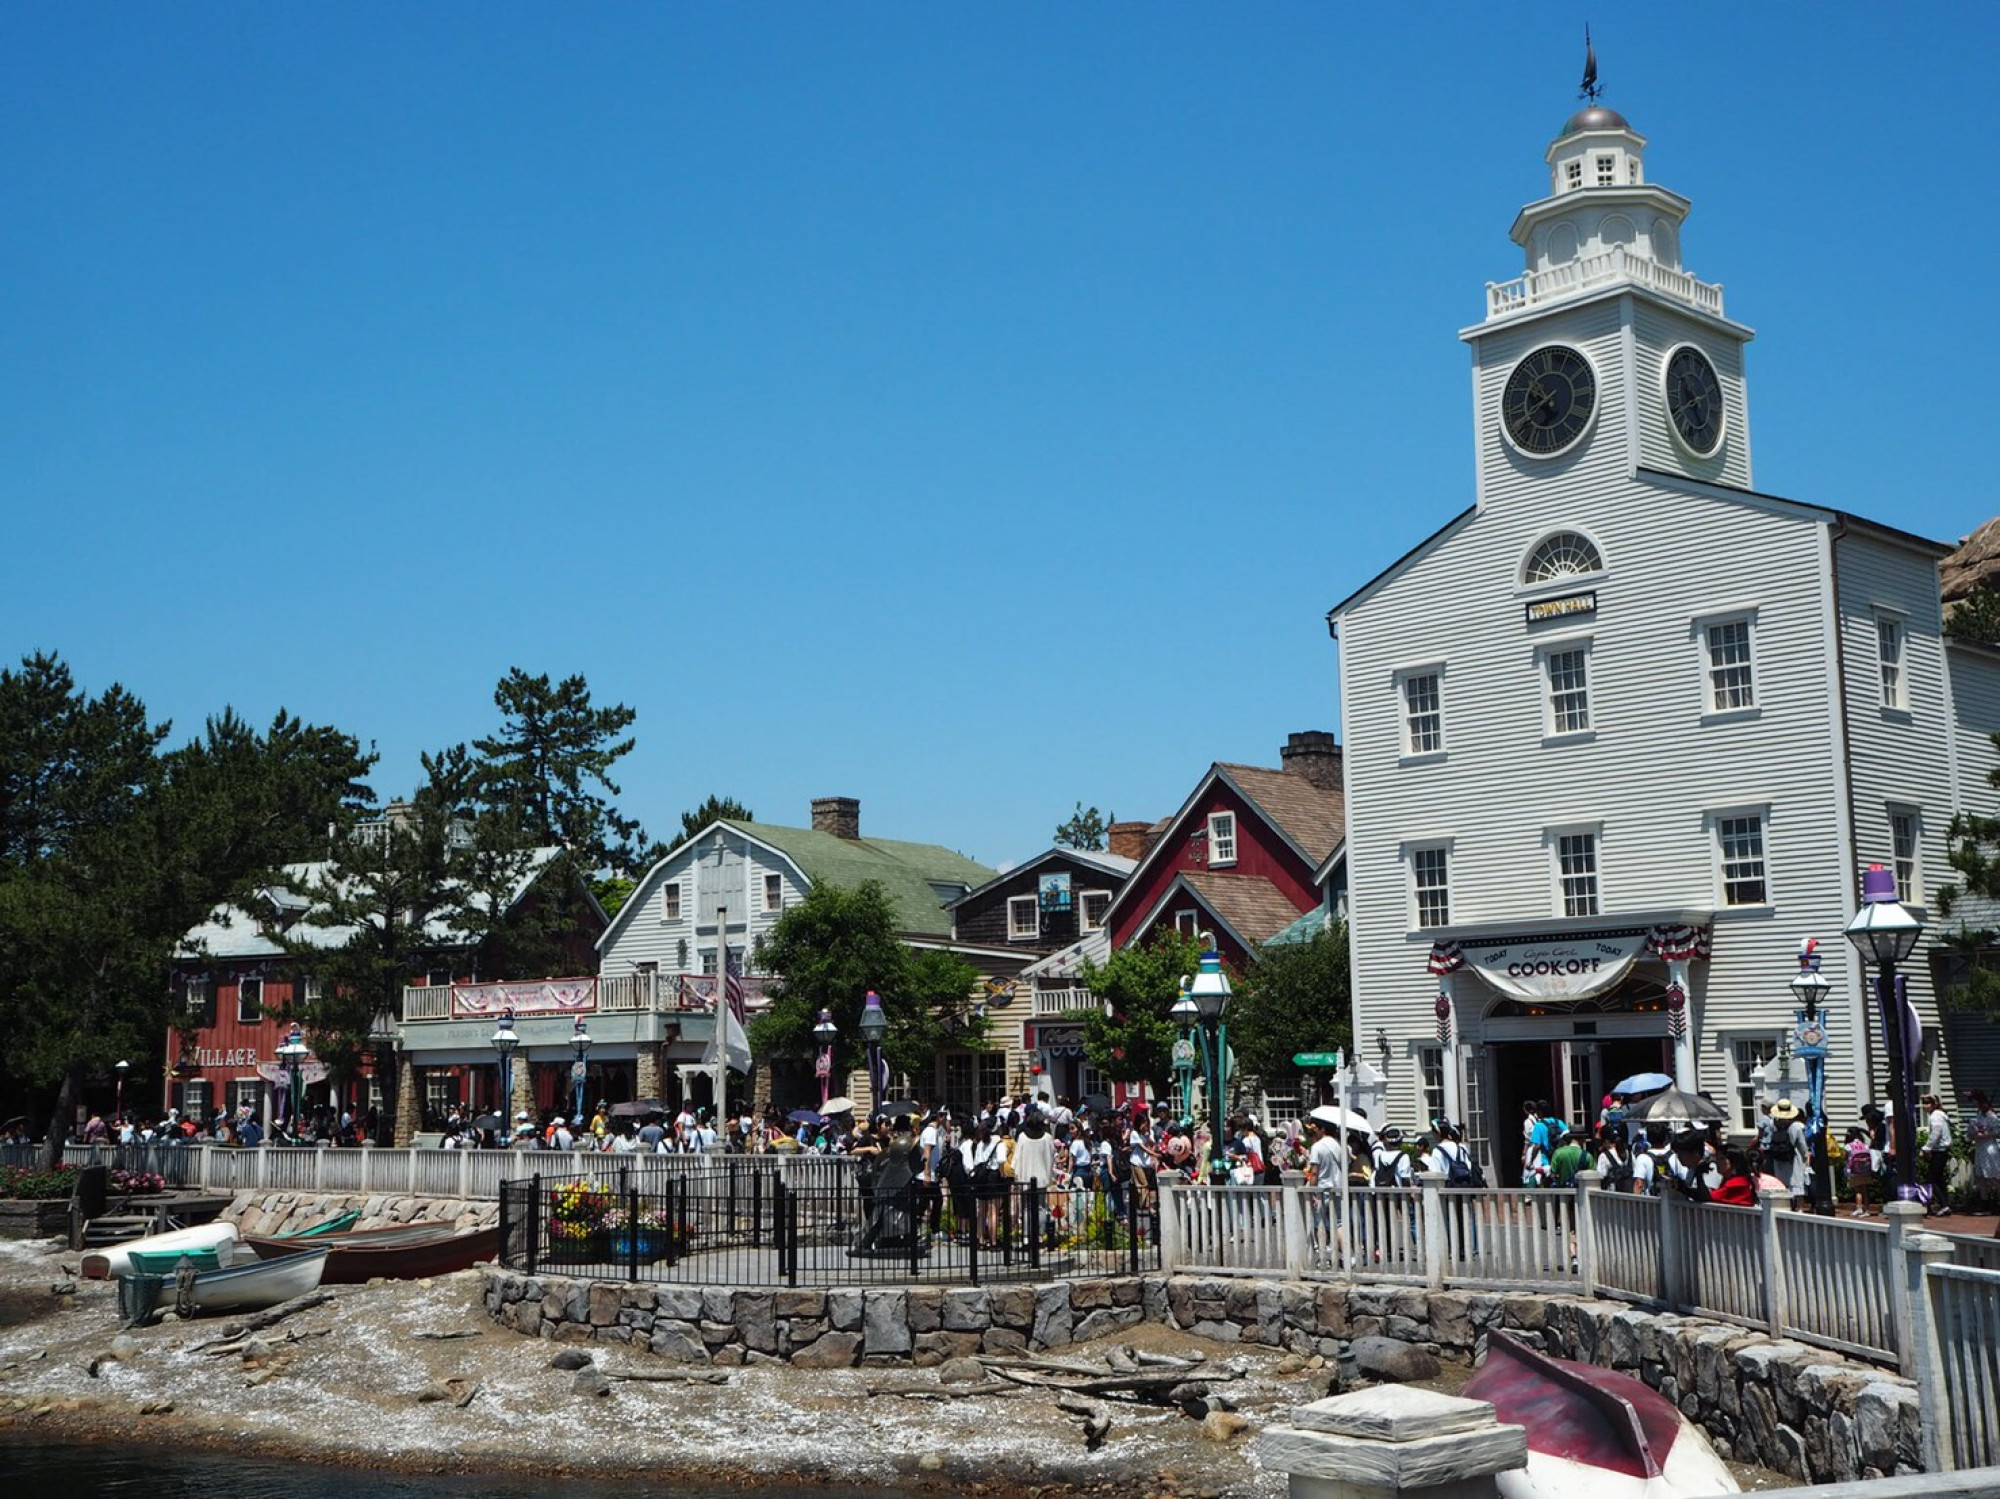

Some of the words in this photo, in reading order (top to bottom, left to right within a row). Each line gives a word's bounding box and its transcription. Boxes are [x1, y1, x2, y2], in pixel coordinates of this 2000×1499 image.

[1531, 600, 1562, 619] TOWN
[1565, 596, 1591, 611] HALL
[1484, 949, 1507, 965] TODAY
[1596, 943, 1623, 957] TODAY
[1508, 958, 1600, 977] COOK-OFF
